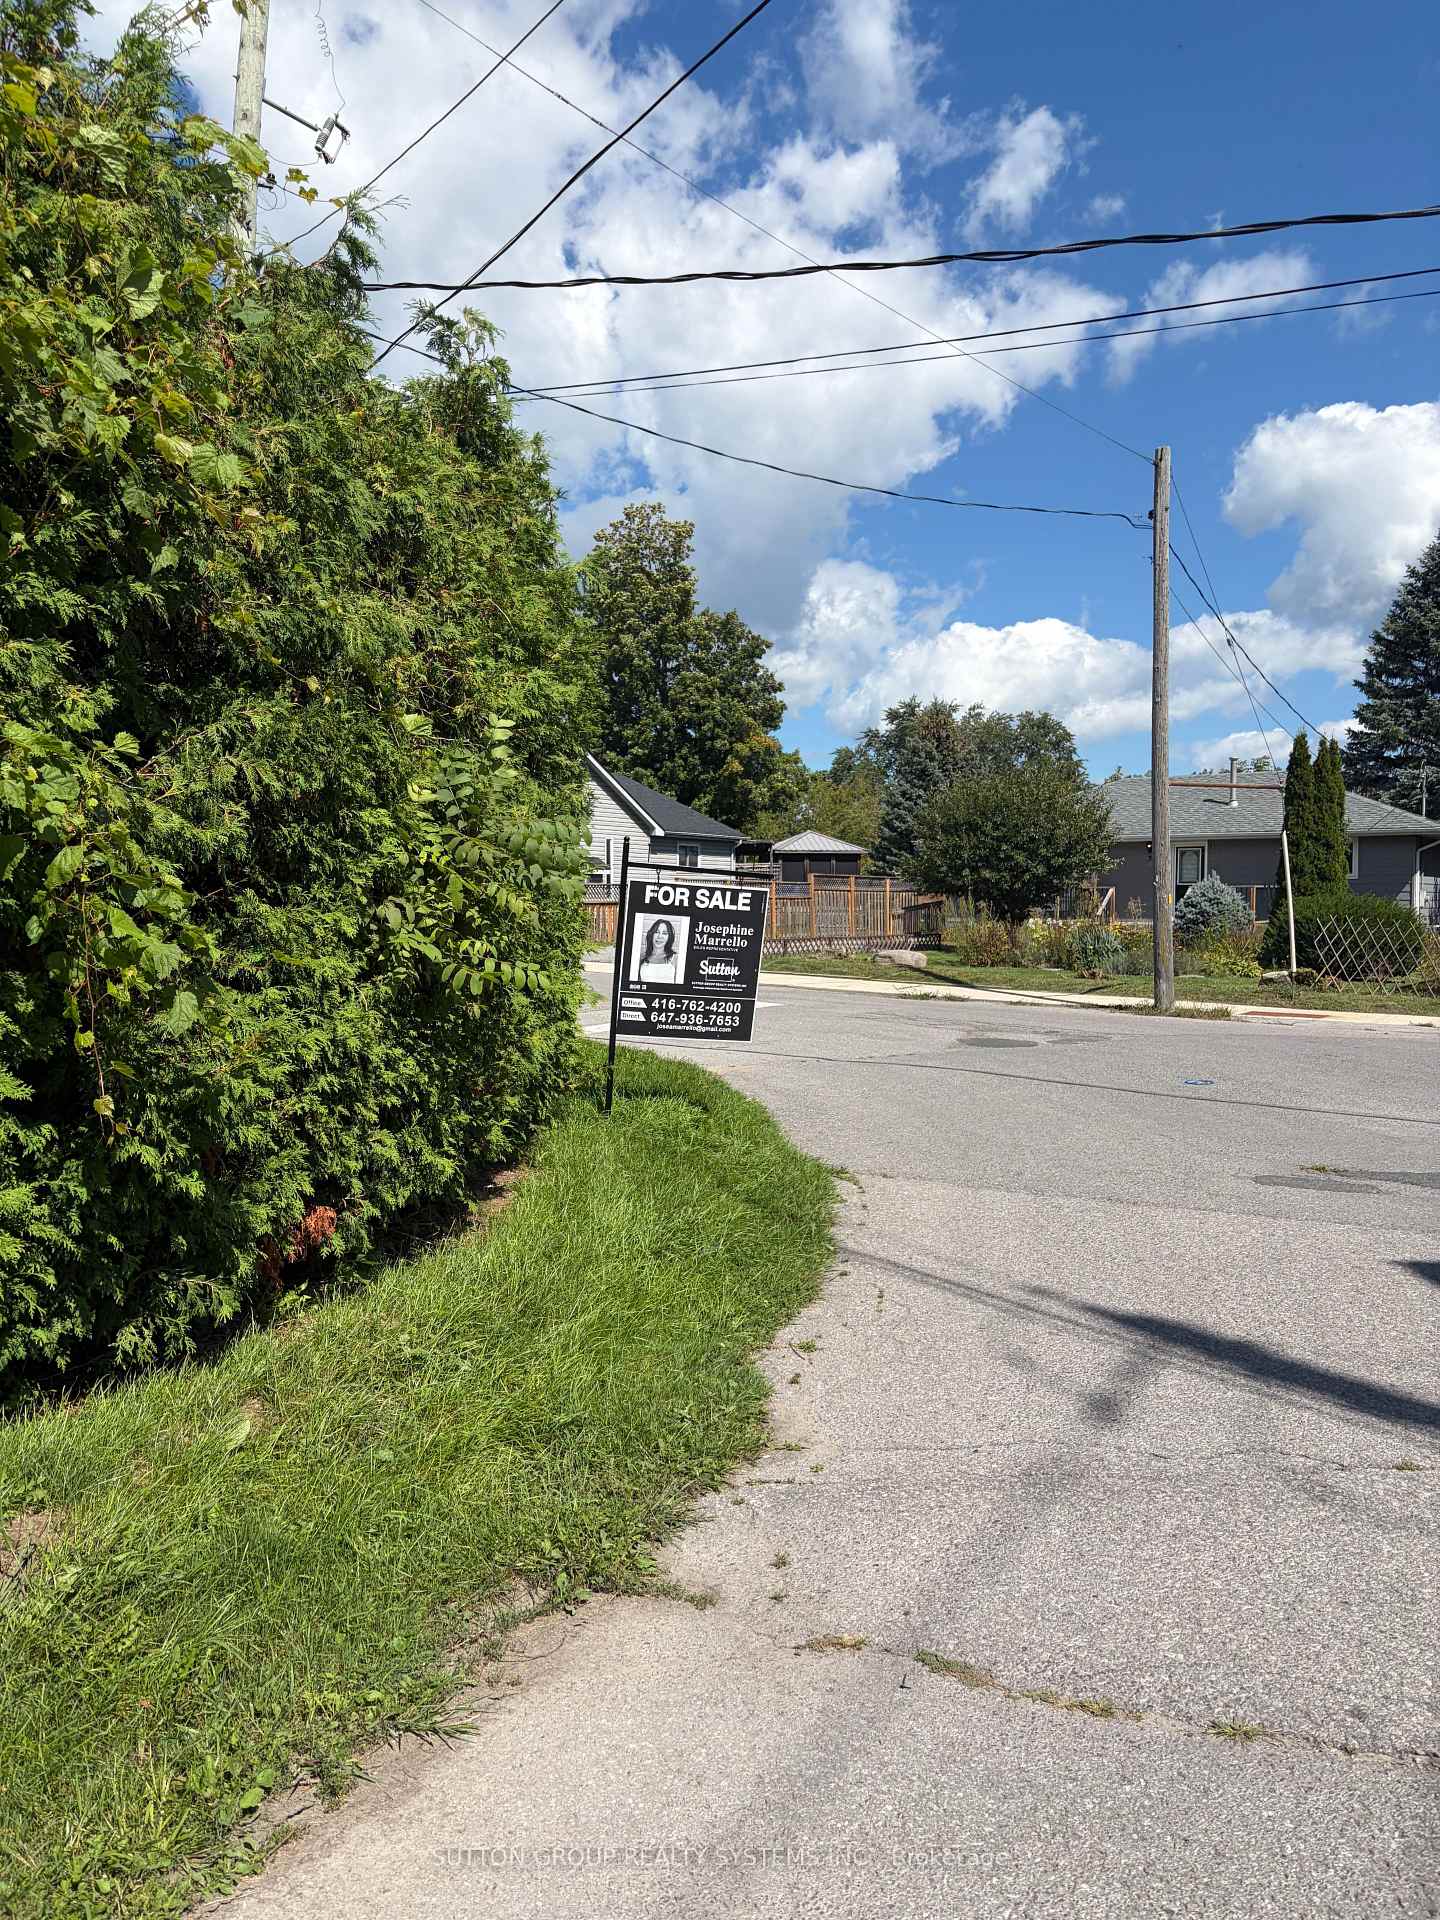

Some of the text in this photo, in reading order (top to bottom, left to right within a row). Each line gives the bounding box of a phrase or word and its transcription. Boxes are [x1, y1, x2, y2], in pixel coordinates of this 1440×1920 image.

[644, 884, 752, 911] FOR SALE
[695, 921, 754, 937] Josephine
[694, 933, 748, 948] Marrello
[699, 959, 741, 976] Sutton
[651, 998, 741, 1014] 416-762-4200
[650, 1011, 740, 1027] 647-936-7653
